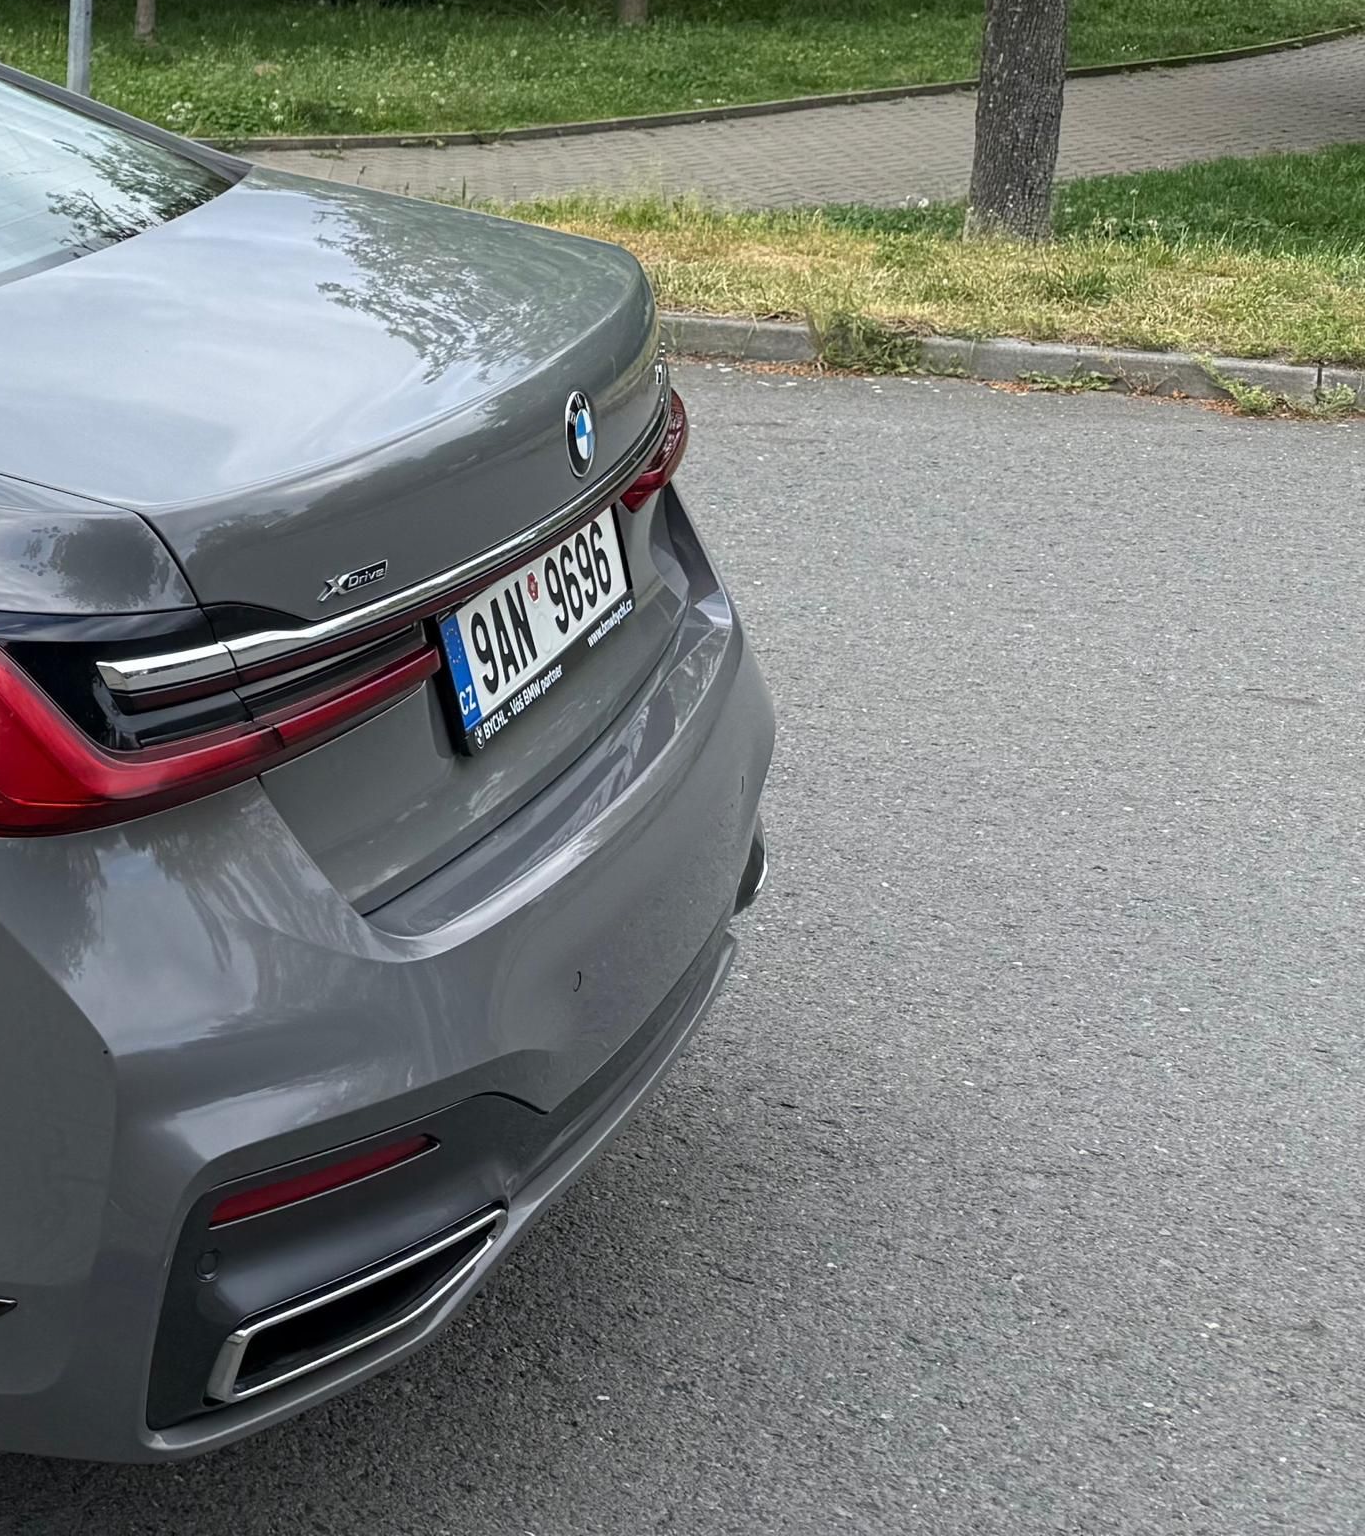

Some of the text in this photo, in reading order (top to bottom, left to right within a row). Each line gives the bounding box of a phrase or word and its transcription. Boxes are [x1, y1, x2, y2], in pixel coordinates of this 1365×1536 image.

[470, 521, 611, 695] 9AN 9696
[459, 684, 477, 716] CZ
[482, 710, 509, 740] BYCHL
[523, 679, 541, 706] BMW
[540, 664, 563, 695] partner
